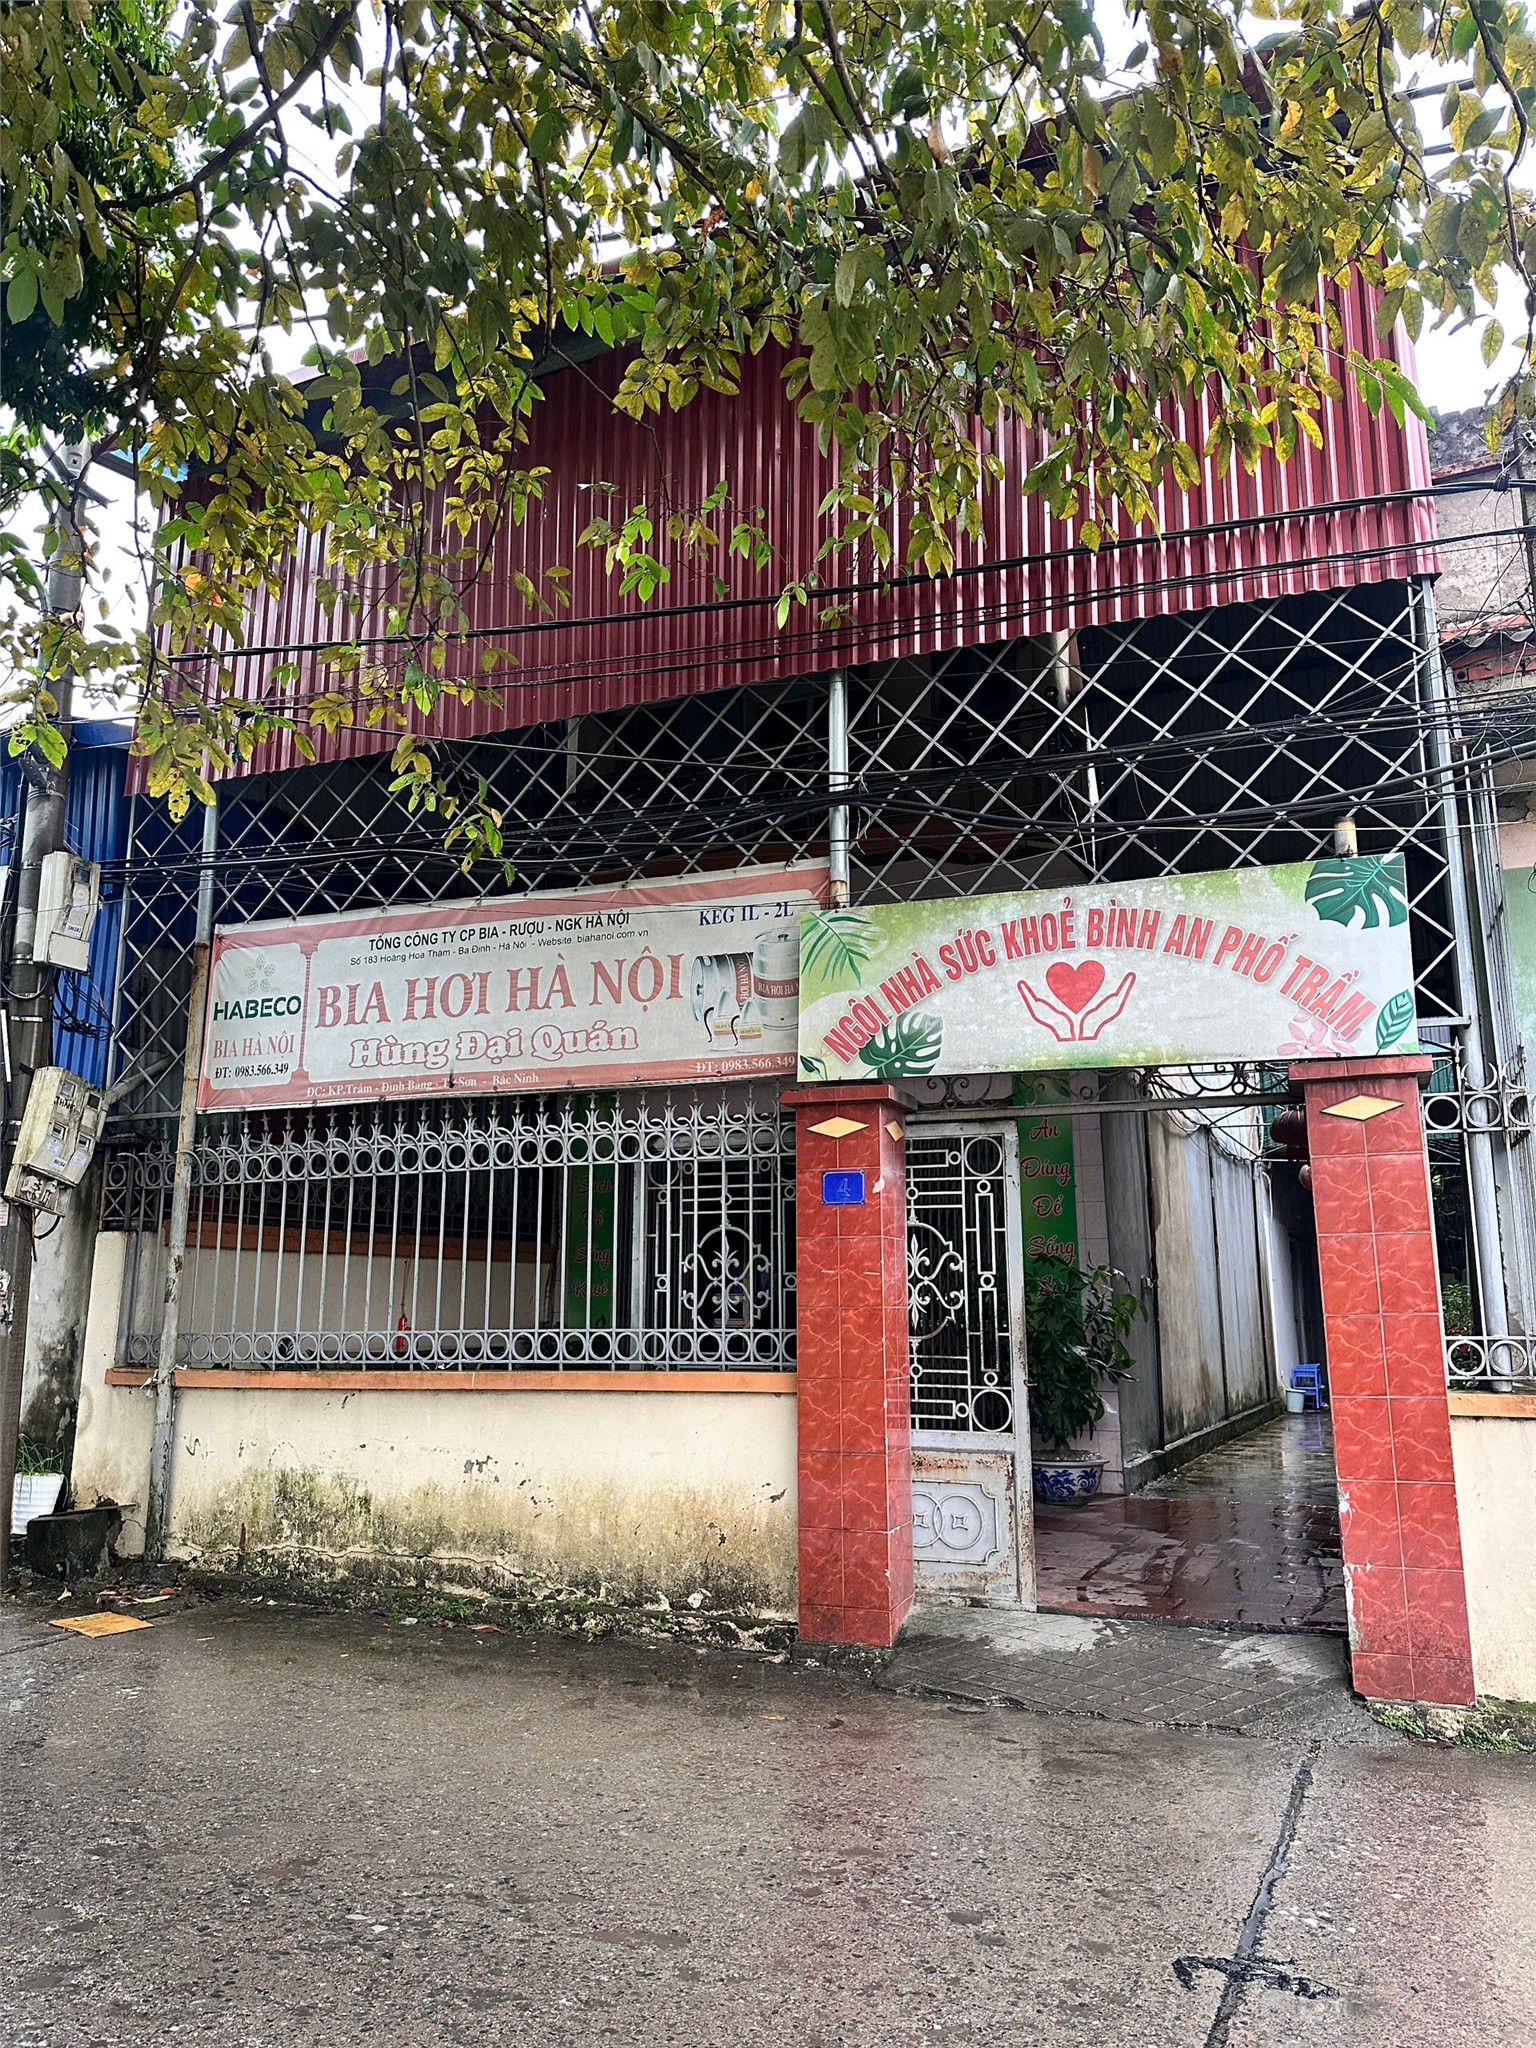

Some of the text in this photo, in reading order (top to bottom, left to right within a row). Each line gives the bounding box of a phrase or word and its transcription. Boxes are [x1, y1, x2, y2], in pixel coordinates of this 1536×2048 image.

[699, 908, 735, 926] KEG
[774, 902, 794, 918] 2L
[404, 932, 438, 948] CÔNG
[442, 930, 457, 944] TY
[460, 928, 476, 942] CP
[479, 926, 499, 940] BIA
[509, 920, 544, 938] RƯỢU
[556, 917, 582, 932] NGK
[586, 911, 603, 928] HÀ
[607, 909, 630, 928] NỘI
[364, 955, 378, 964] 183
[408, 952, 424, 960] Hoa
[458, 946, 470, 955] Ba
[315, 946, 685, 1029] BIA HƠI HÀ NỘI
[822, 896, 1378, 1065] NGÔI NHÀ SỨC KHOẺ BÌNH AN PHỐ TRẦM
[213, 996, 302, 1020] HABECO
[212, 1030, 295, 1058] BIA HÀ NỘI
[349, 1020, 639, 1070] Hùng Đại Quán
[215, 1062, 289, 1078] ĐT: 0983.566.349
[696, 1056, 795, 1072] ĐT: 0983.566.349
[306, 1087, 326, 1097] ĐC:
[381, 1081, 404, 1092] Đình
[442, 1077, 456, 1088] T
[458, 1076, 476, 1087] Sơn
[514, 1072, 539, 1084] Ninh
[1020, 1156, 1070, 1186] Đúng
[1032, 1194, 1064, 1218] Để
[575, 1242, 610, 1270] Sng
[1027, 1235, 1075, 1266] Sống
[572, 1280, 608, 1297] Koẻ
